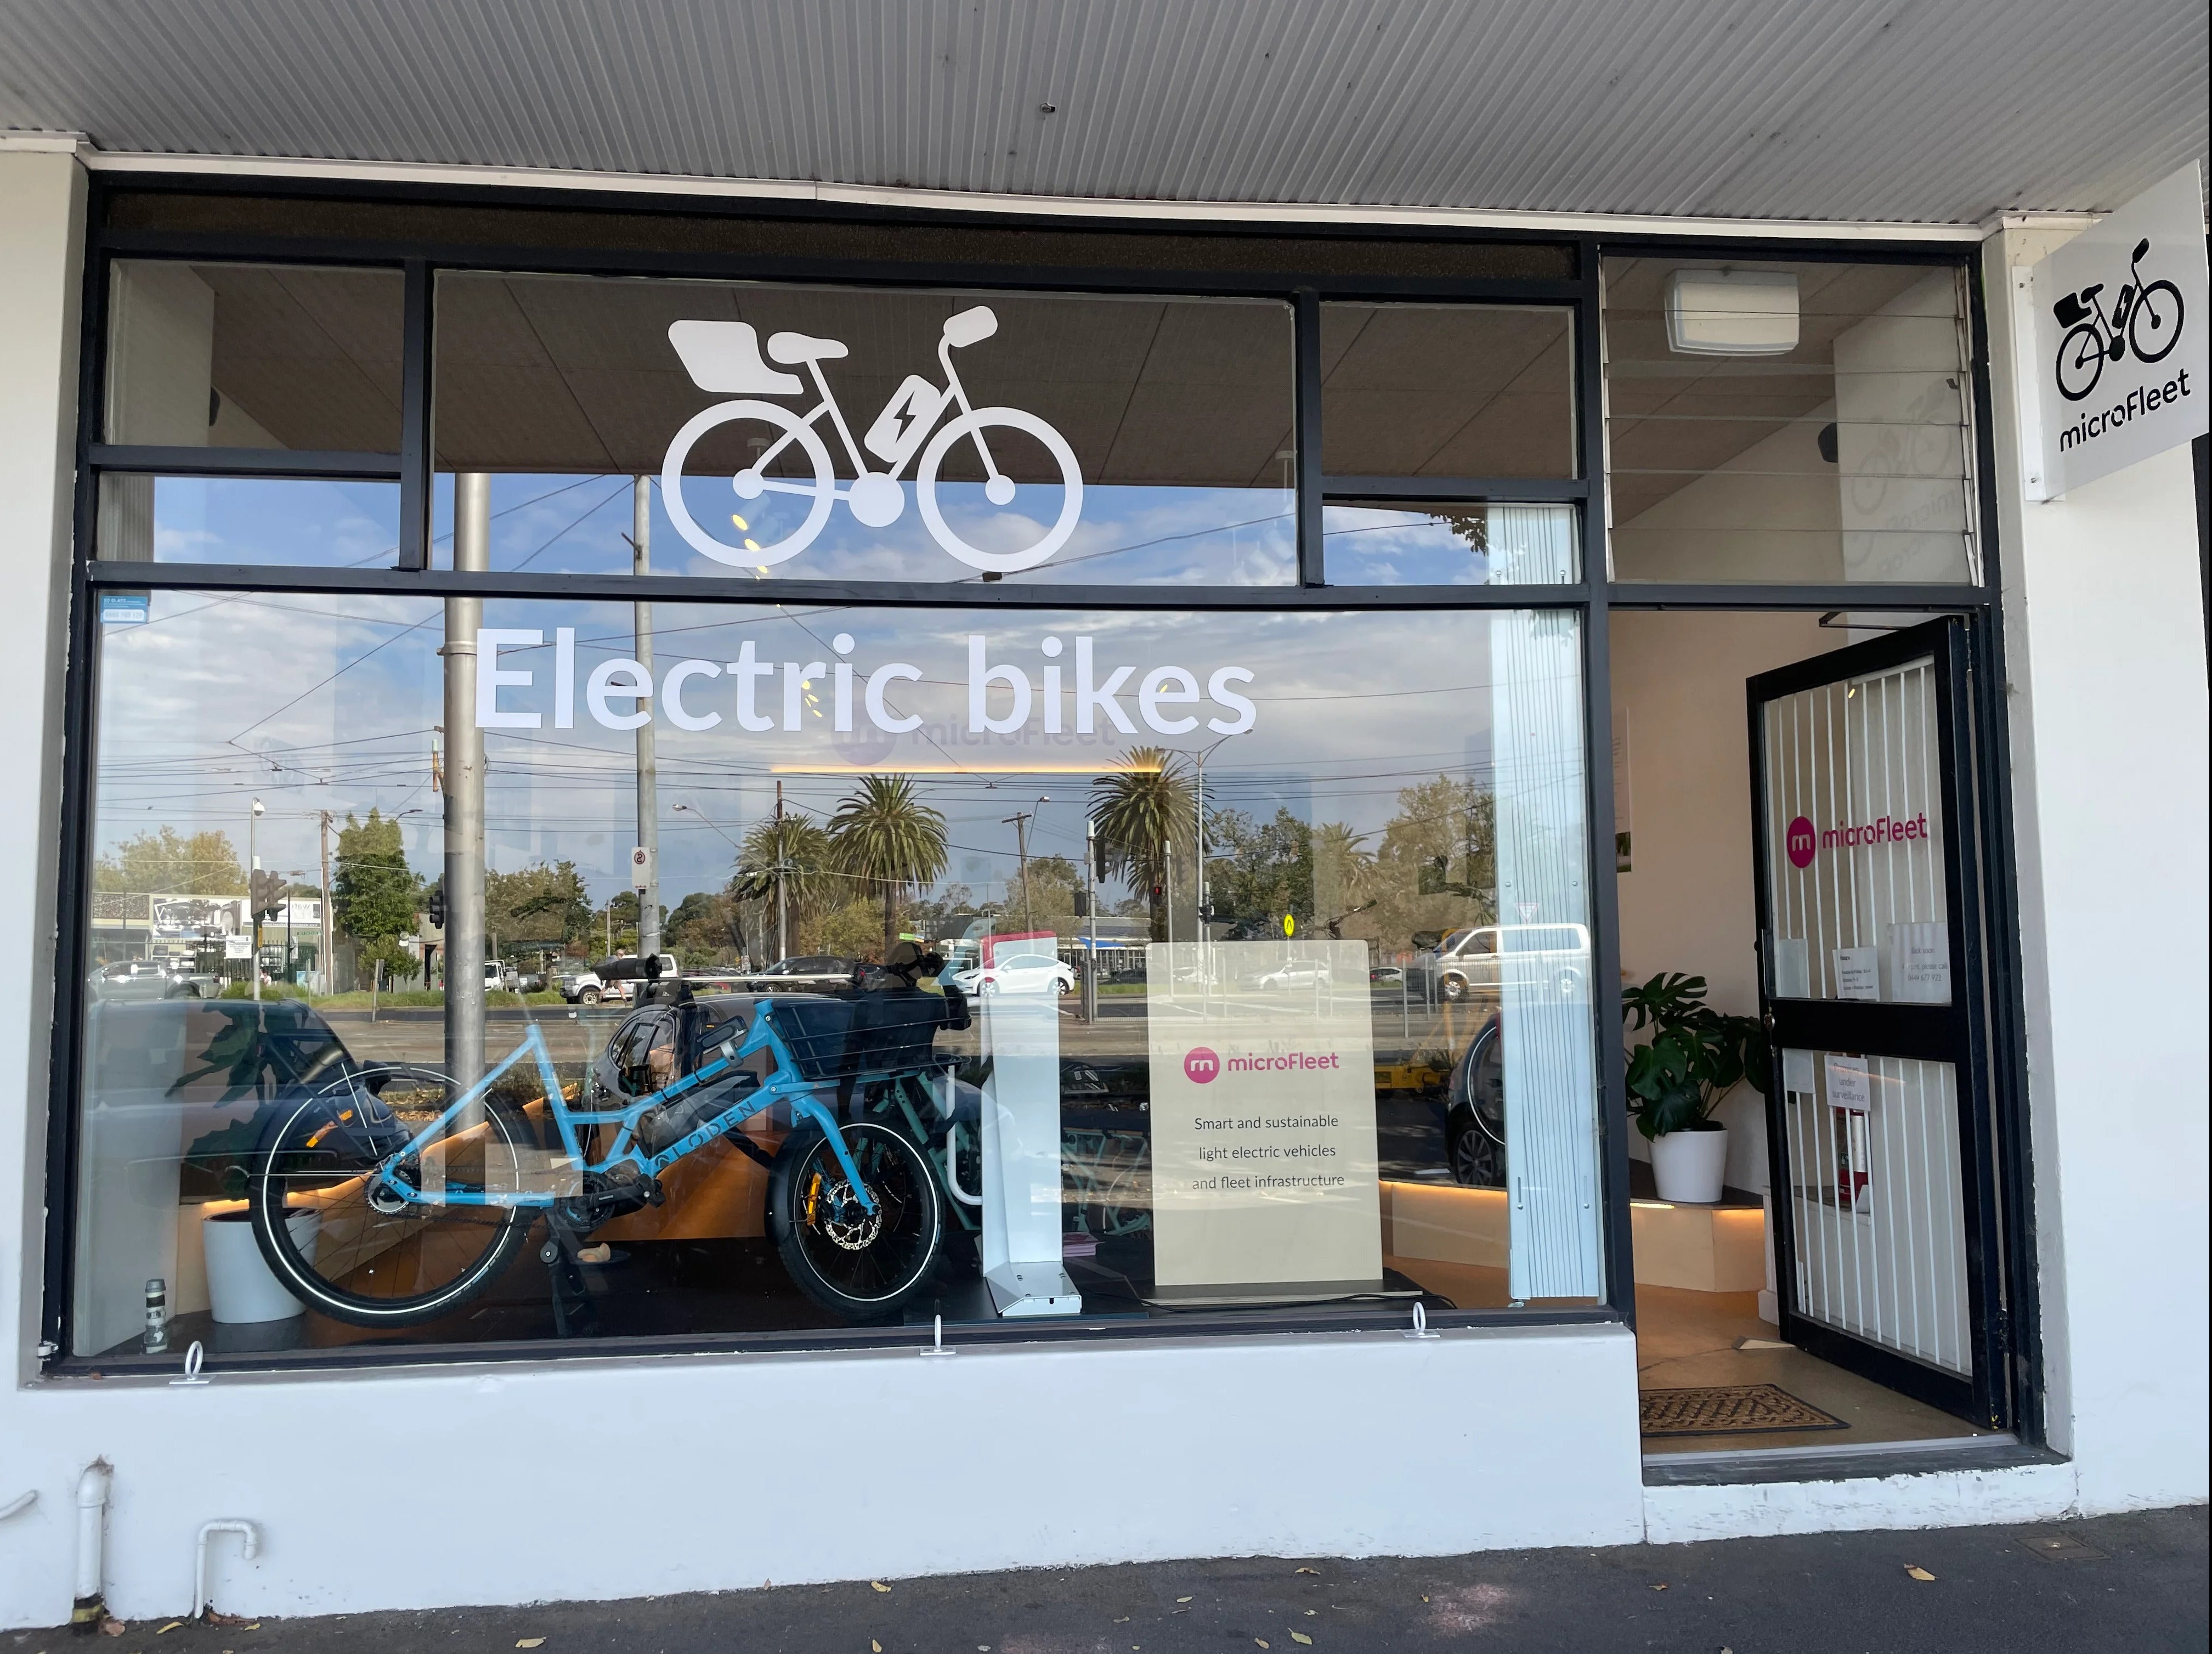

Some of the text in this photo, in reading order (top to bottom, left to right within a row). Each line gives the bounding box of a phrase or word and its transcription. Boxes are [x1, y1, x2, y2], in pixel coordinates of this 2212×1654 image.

[2060, 368, 2191, 451] microFleet
[475, 628, 1256, 735] Electric bikes
[1823, 812, 1928, 849] microFleet
[1228, 1052, 1339, 1071] microFleet
[1838, 1077, 1856, 1087] under
[1832, 1091, 1865, 1102] surveillance
[1195, 1115, 1339, 1130] Smart and sustainable
[1199, 1144, 1336, 1162] light electric vehicles
[1192, 1175, 1345, 1189] and fleet infrastructure
